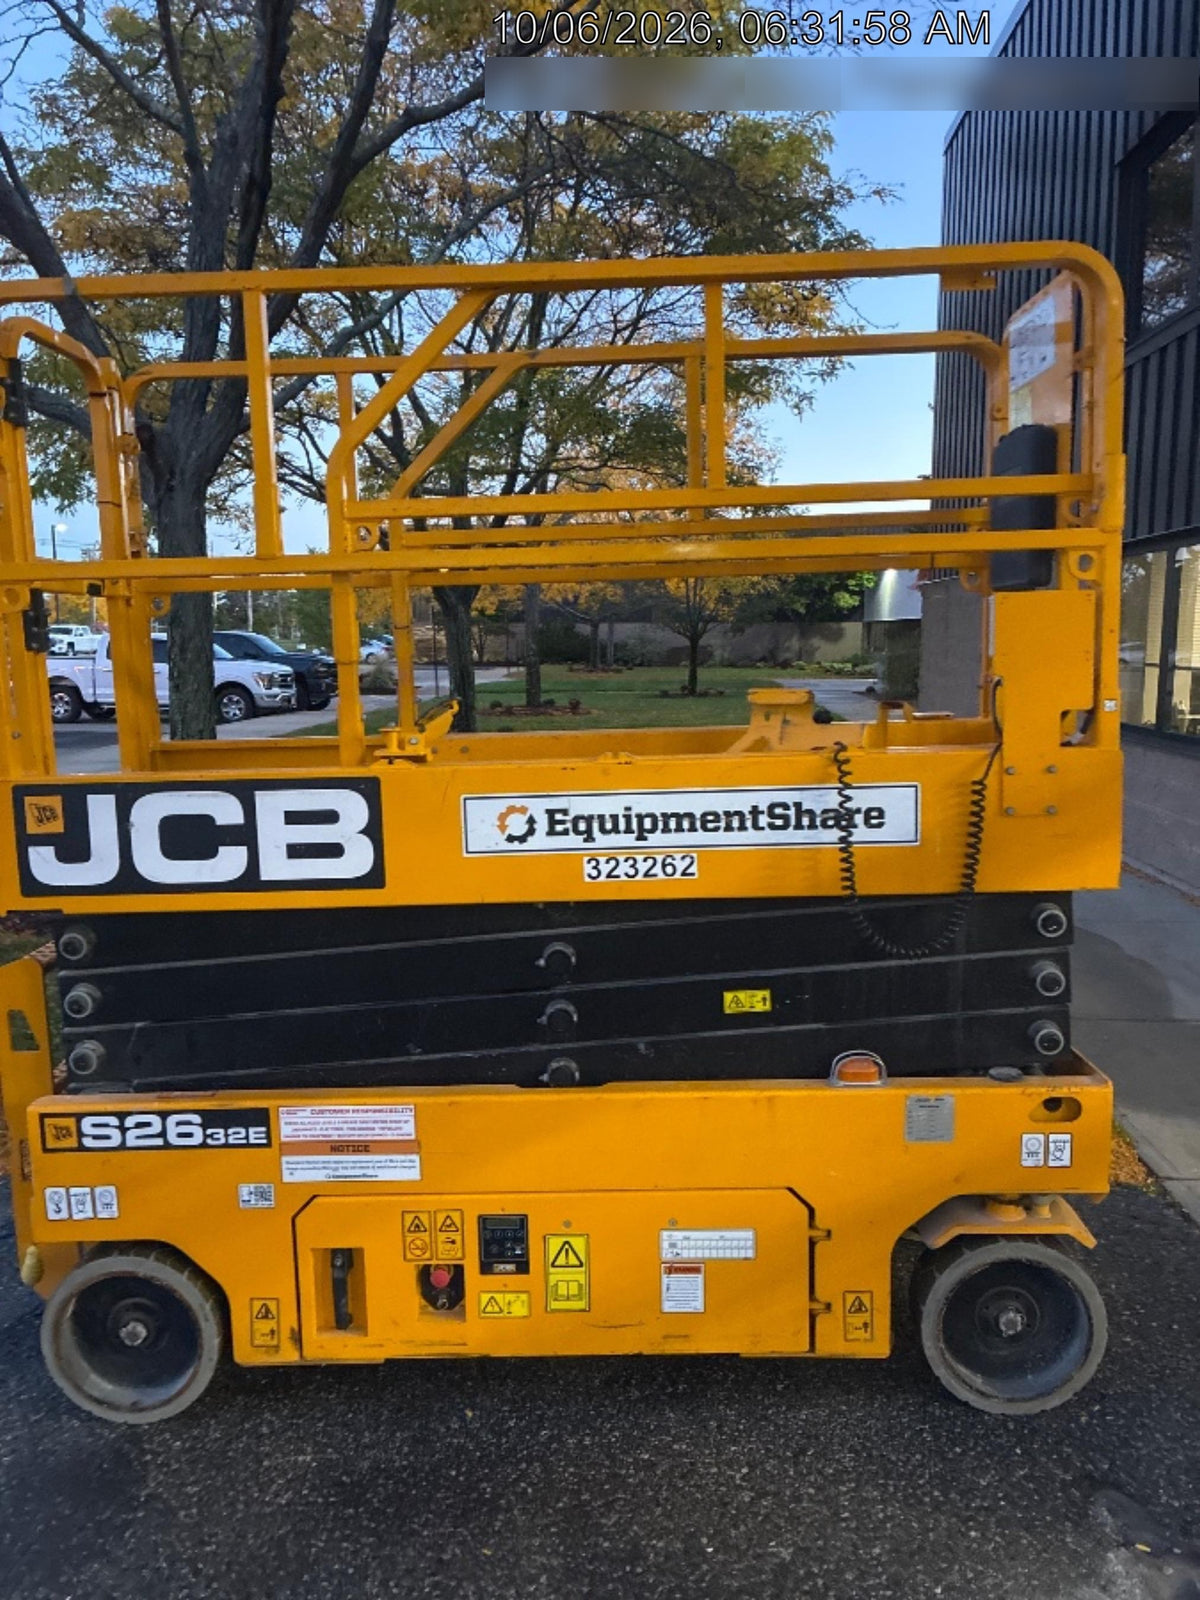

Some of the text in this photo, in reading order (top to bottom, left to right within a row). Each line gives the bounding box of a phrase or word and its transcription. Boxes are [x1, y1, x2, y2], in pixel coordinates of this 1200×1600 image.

[28, 788, 375, 886] JCB
[544, 801, 886, 842] EquipmentShare
[585, 854, 697, 881] 323262
[330, 1144, 370, 1153] NOTICE
